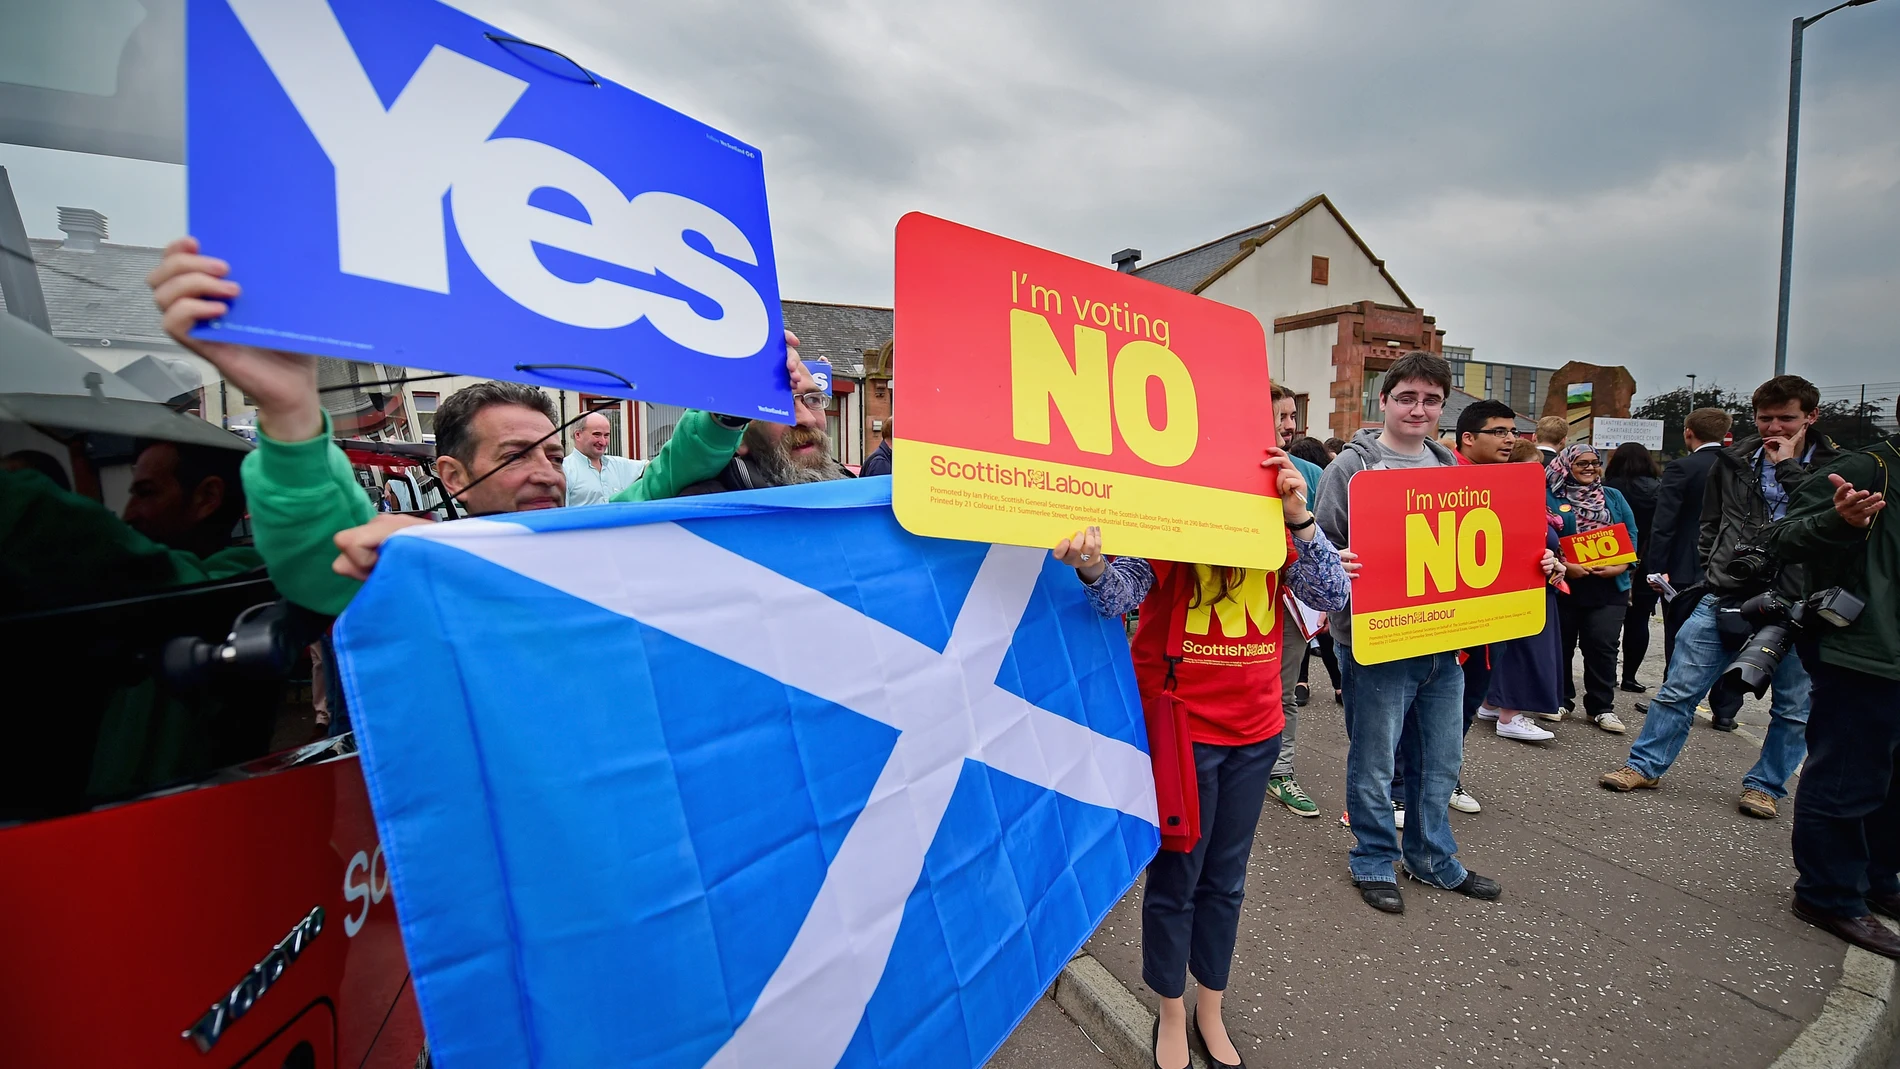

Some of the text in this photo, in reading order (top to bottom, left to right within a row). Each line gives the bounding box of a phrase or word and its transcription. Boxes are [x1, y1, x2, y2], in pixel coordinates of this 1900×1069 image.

[225, 0, 769, 359] Yes
[1011, 270, 1170, 348] I'm voting
[1010, 308, 1198, 468] NO
[930, 455, 1113, 500] Scottish Labour
[930, 486, 962, 497] Promoted
[963, 490, 972, 499] by
[984, 493, 1000, 502] Price,
[1001, 495, 1024, 504] Scottish
[1025, 498, 1047, 507] General
[1048, 502, 1074, 511] Secretary
[1119, 511, 1139, 519] Scottish
[1140, 513, 1157, 522] Labour
[930, 496, 954, 505] Printed
[955, 499, 963, 508] by
[973, 502, 994, 510] Colour
[1018, 507, 1050, 517] Summerlee
[1098, 517, 1122, 526] Industrial
[1406, 486, 1490, 511] I'm voting
[1573, 536, 1619, 562] NO
[1586, 530, 1614, 540] voting
[1406, 508, 1503, 598] NO
[1369, 608, 1455, 630] Scottish Labour
[1182, 640, 1246, 656] Scottish
